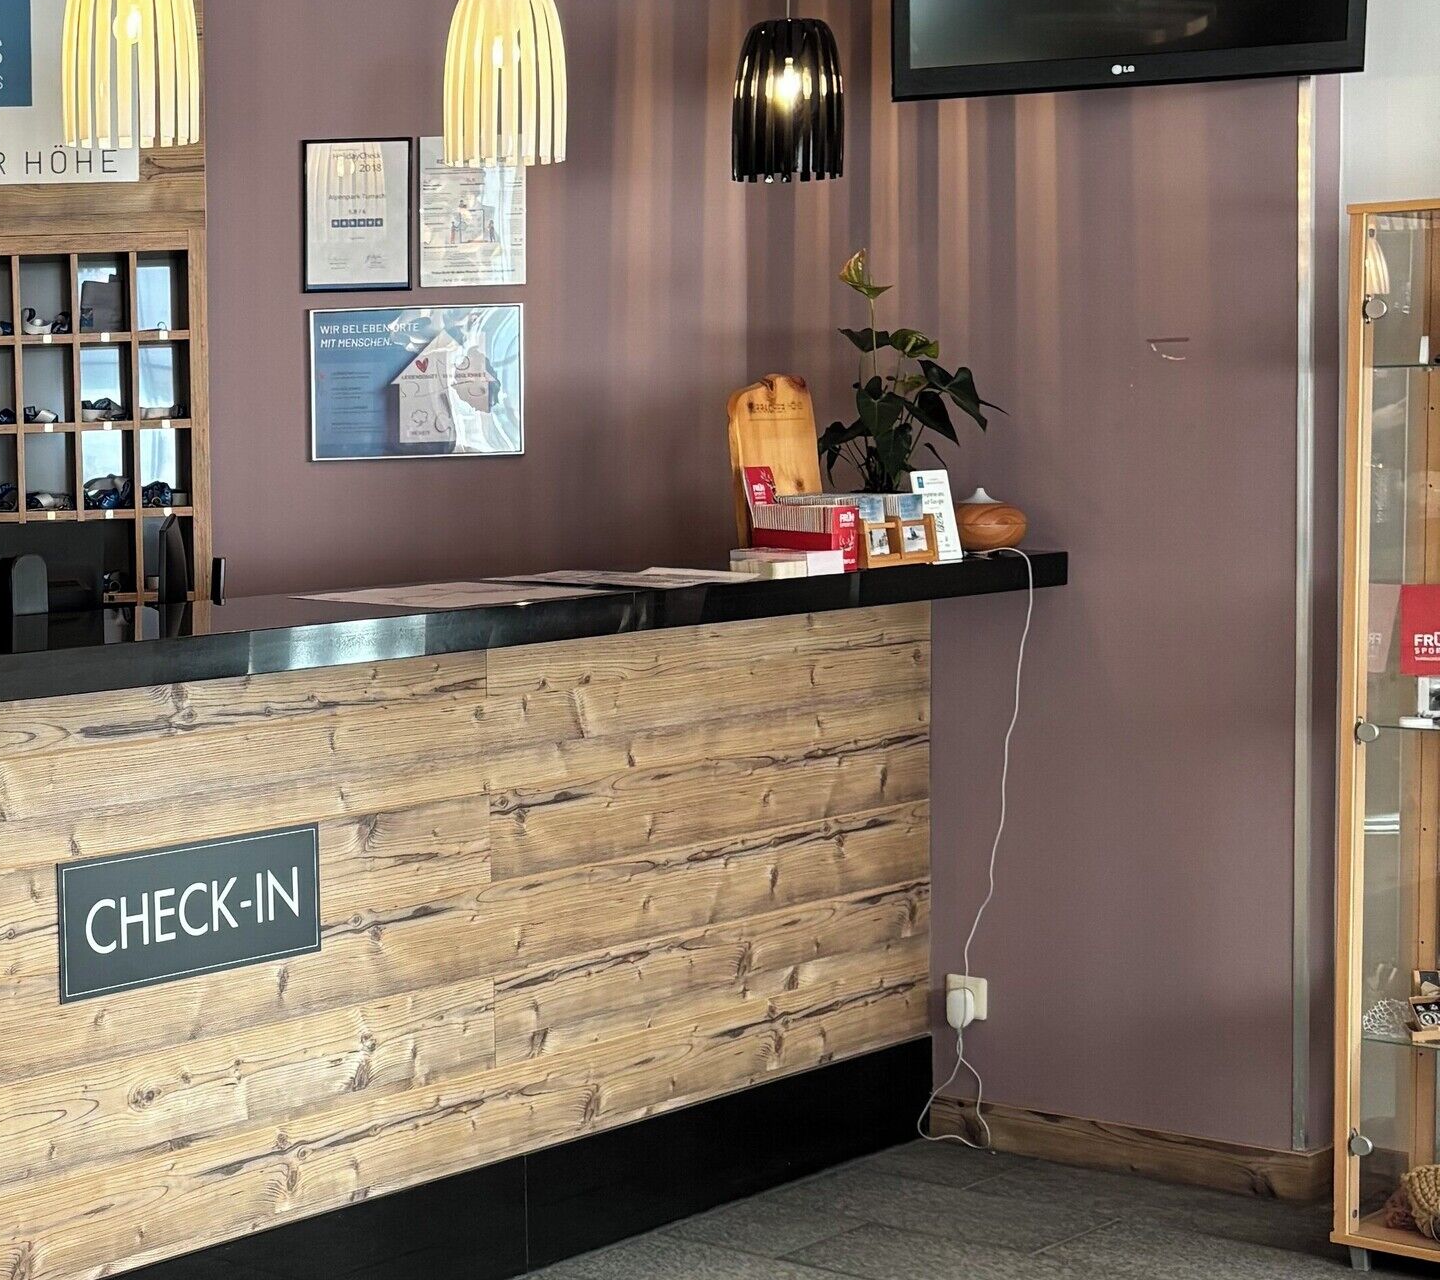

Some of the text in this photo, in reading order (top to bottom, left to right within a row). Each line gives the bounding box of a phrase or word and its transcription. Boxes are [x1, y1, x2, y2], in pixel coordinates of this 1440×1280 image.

[24, 144, 118, 174] HÖHE
[320, 322, 420, 335] WIR BELEBEN ORTE
[320, 337, 392, 348] MIT MENSCHEN.
[85, 866, 300, 954] CHECK-IN
